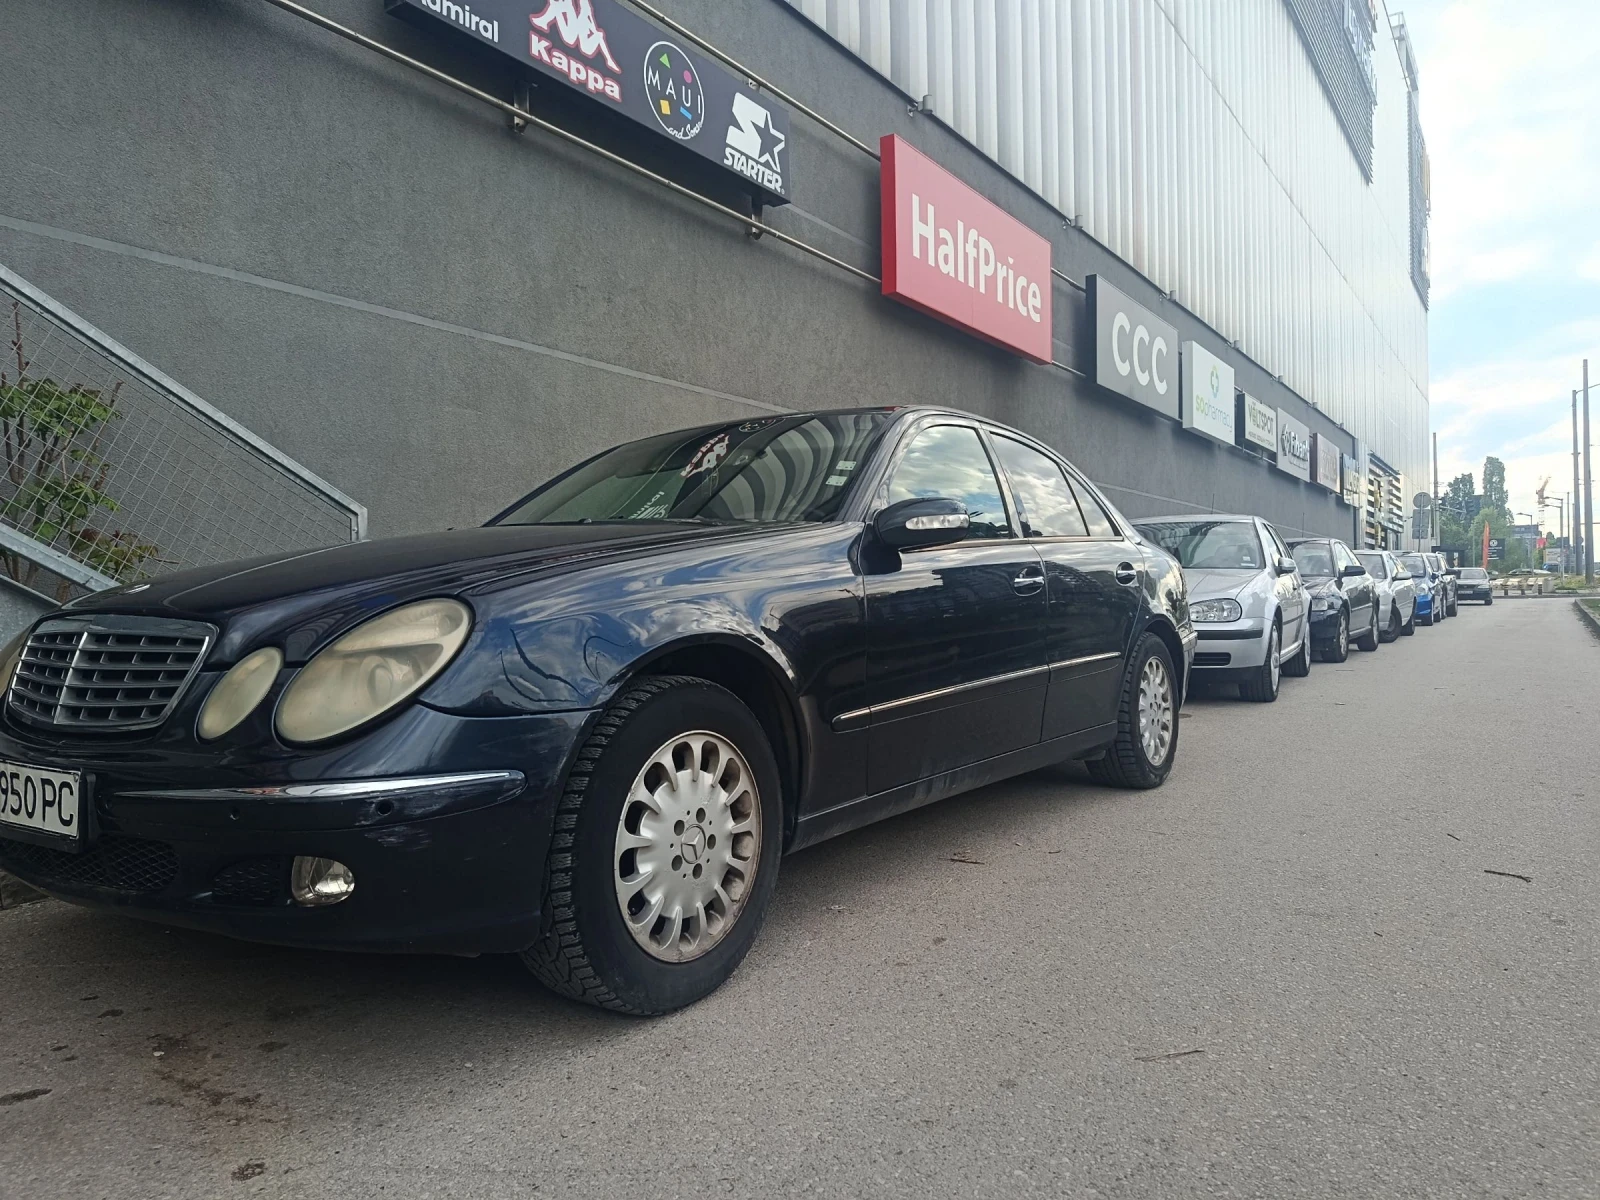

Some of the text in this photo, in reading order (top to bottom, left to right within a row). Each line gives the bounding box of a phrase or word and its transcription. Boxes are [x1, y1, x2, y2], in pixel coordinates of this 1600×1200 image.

[421, 0, 499, 43] dmiral
[529, 32, 622, 102] Kappa
[647, 65, 702, 115] MAUI
[723, 147, 783, 193] STARTER
[911, 193, 1042, 323] HalfPrice
[1111, 311, 1169, 395] CCC
